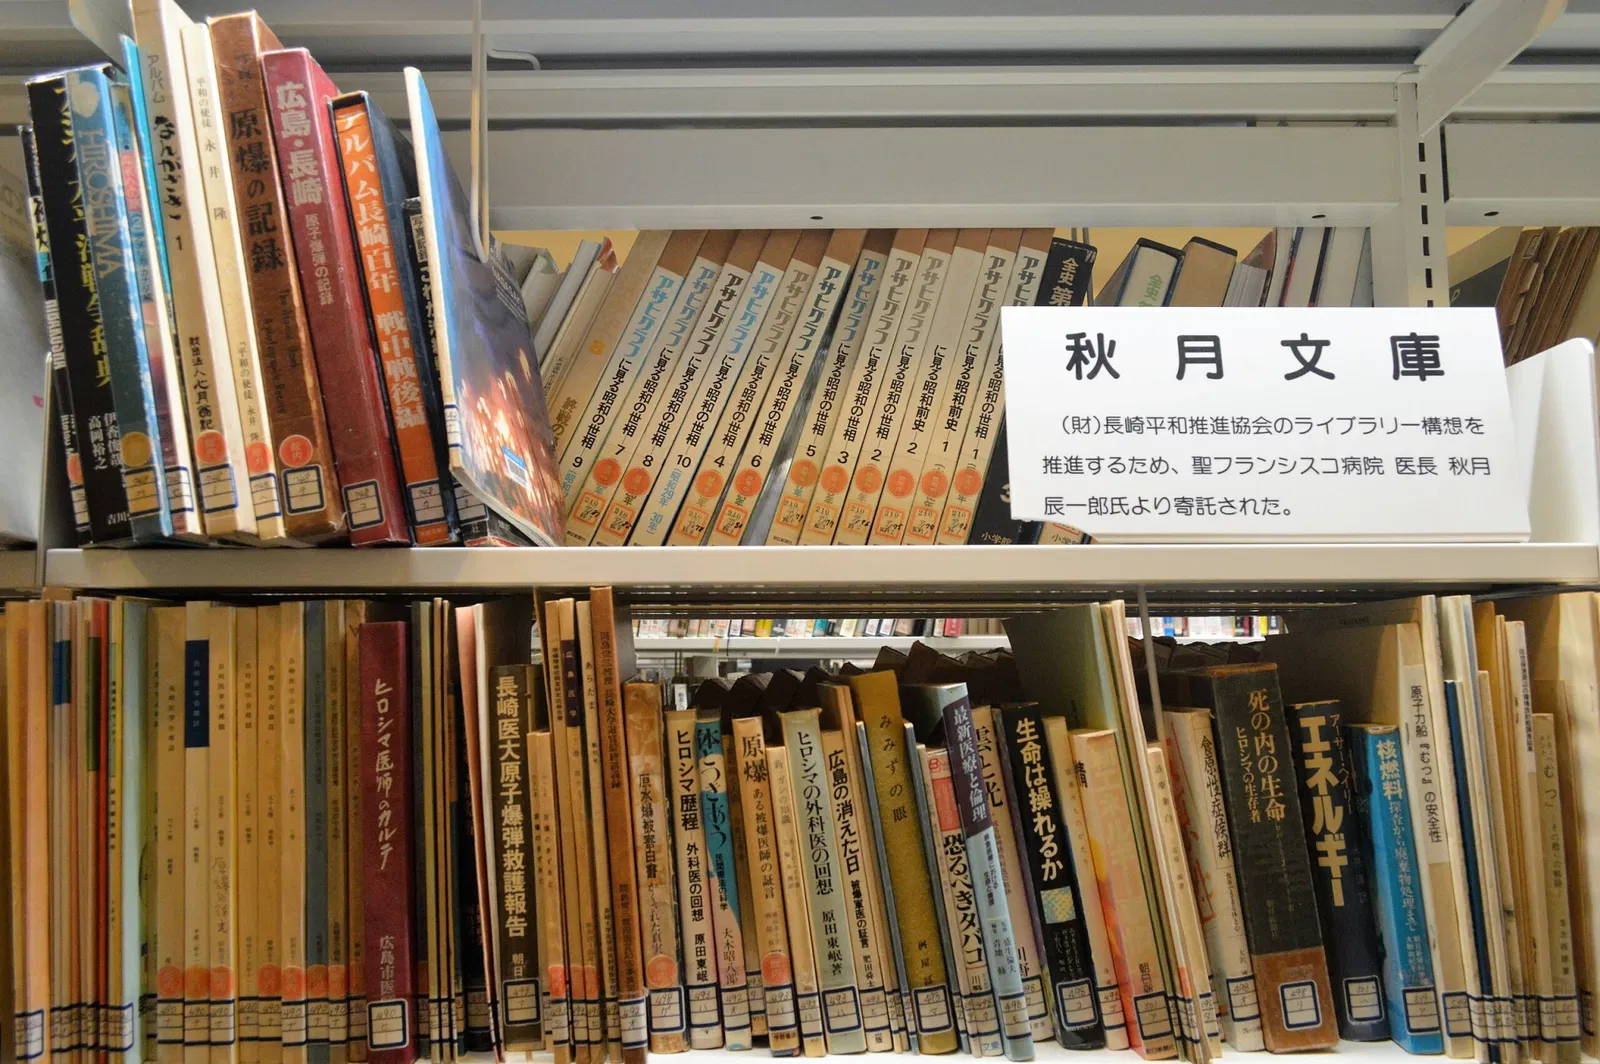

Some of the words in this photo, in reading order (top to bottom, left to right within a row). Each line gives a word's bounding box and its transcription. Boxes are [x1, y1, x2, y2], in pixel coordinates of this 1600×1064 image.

[276, 81, 323, 206] 広島・長崎
[79, 129, 123, 281] HIROSHIMA
[229, 108, 285, 273] 原爆の記録
[337, 111, 398, 293] アルバム長崎百年
[376, 311, 426, 429] 戦中戦後編
[912, 345, 947, 432] に見る昭和前史
[1065, 331, 1445, 382] 秋月文庫
[571, 456, 583, 468] 9
[615, 444, 626, 456] 7
[642, 454, 654, 468] 8
[676, 454, 692, 468] 10
[713, 455, 726, 468] 4
[751, 454, 762, 468] 6
[806, 444, 817, 457] 5
[837, 450, 849, 464] 3
[870, 449, 882, 461] 2
[907, 442, 918, 454] 2
[943, 441, 949, 453] 1
[1042, 455, 1385, 476] 推進するため、聖フランシスコ病院
[1395, 456, 1438, 476] 医長
[1448, 456, 1491, 476] 秋月
[1043, 495, 1292, 517] 辰一郎氏より寄託された。
[374, 678, 397, 870] ヒロシマ医師のカルテ
[677, 729, 700, 831] ヒロシマ歴程
[742, 734, 768, 783] 原爆
[879, 715, 908, 824] みみずの眼
[952, 705, 987, 824] 最新医療と倫理
[1236, 726, 1262, 824] ヒロシマの生存者
[1248, 688, 1286, 823] 死の内の生命
[1376, 739, 1403, 800] 核燃料
[1410, 685, 1443, 844] 原子力船『むつ』の安全性
[496, 675, 527, 938] 長崎医大原子爆弾救護報告
[512, 953, 524, 979] 朝日
[639, 774, 658, 879] 原水爆被害白書
[797, 731, 834, 896] ヒロシマの外科医の回想
[1016, 718, 1064, 882] 生命は操れるか
[1299, 715, 1349, 907] エネルギー
[753, 788, 775, 899] ある被爆医師の証言
[828, 749, 860, 876] 広島の消えた日
[851, 879, 869, 949] 被爆軍医の証言
[686, 843, 704, 922] 外科医の回想
[943, 834, 984, 965] 恐るべきタバコ
[379, 935, 396, 1000] 広島市医
[694, 933, 708, 982] 原田東岷
[1068, 987, 1086, 998] 498
[376, 1007, 396, 1018] 490
[829, 992, 847, 1004] 493
